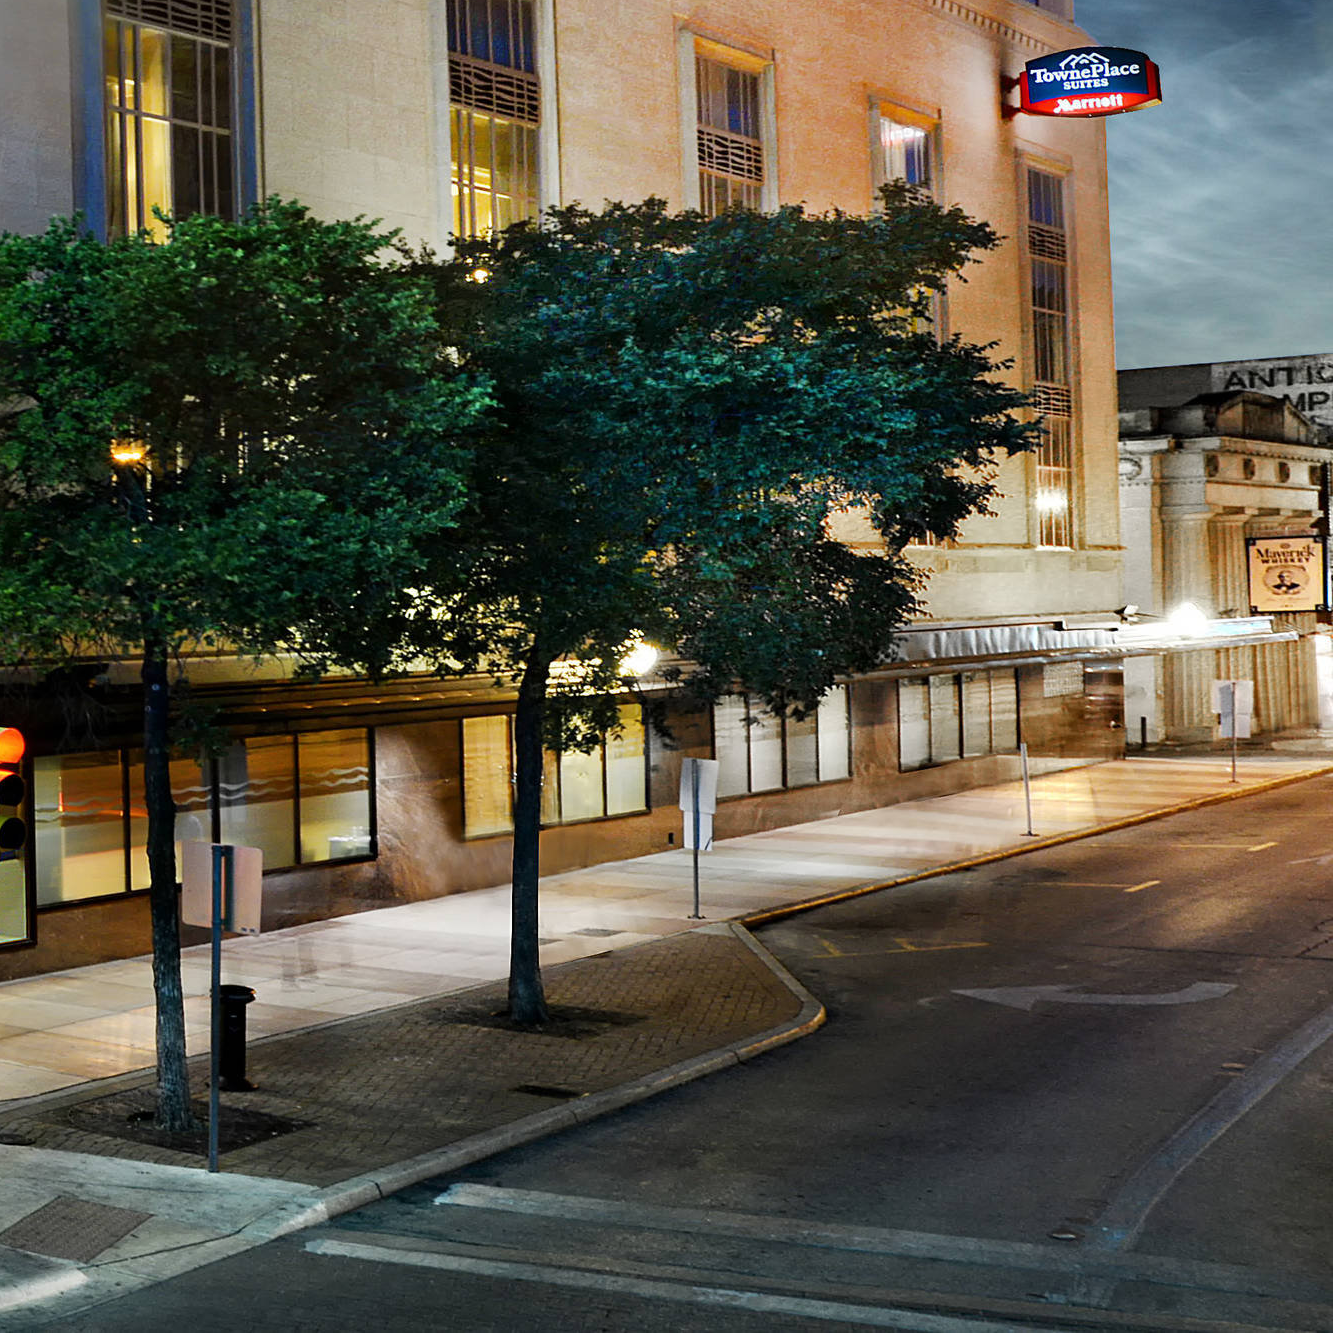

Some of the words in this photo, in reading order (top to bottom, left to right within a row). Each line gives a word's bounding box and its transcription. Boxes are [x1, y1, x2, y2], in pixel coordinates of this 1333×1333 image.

[1030, 63, 1140, 84] TownePlace
[1063, 78, 1109, 90] SUITES
[1053, 94, 1123, 113] Marriott
[1256, 544, 1315, 559] Maverick
